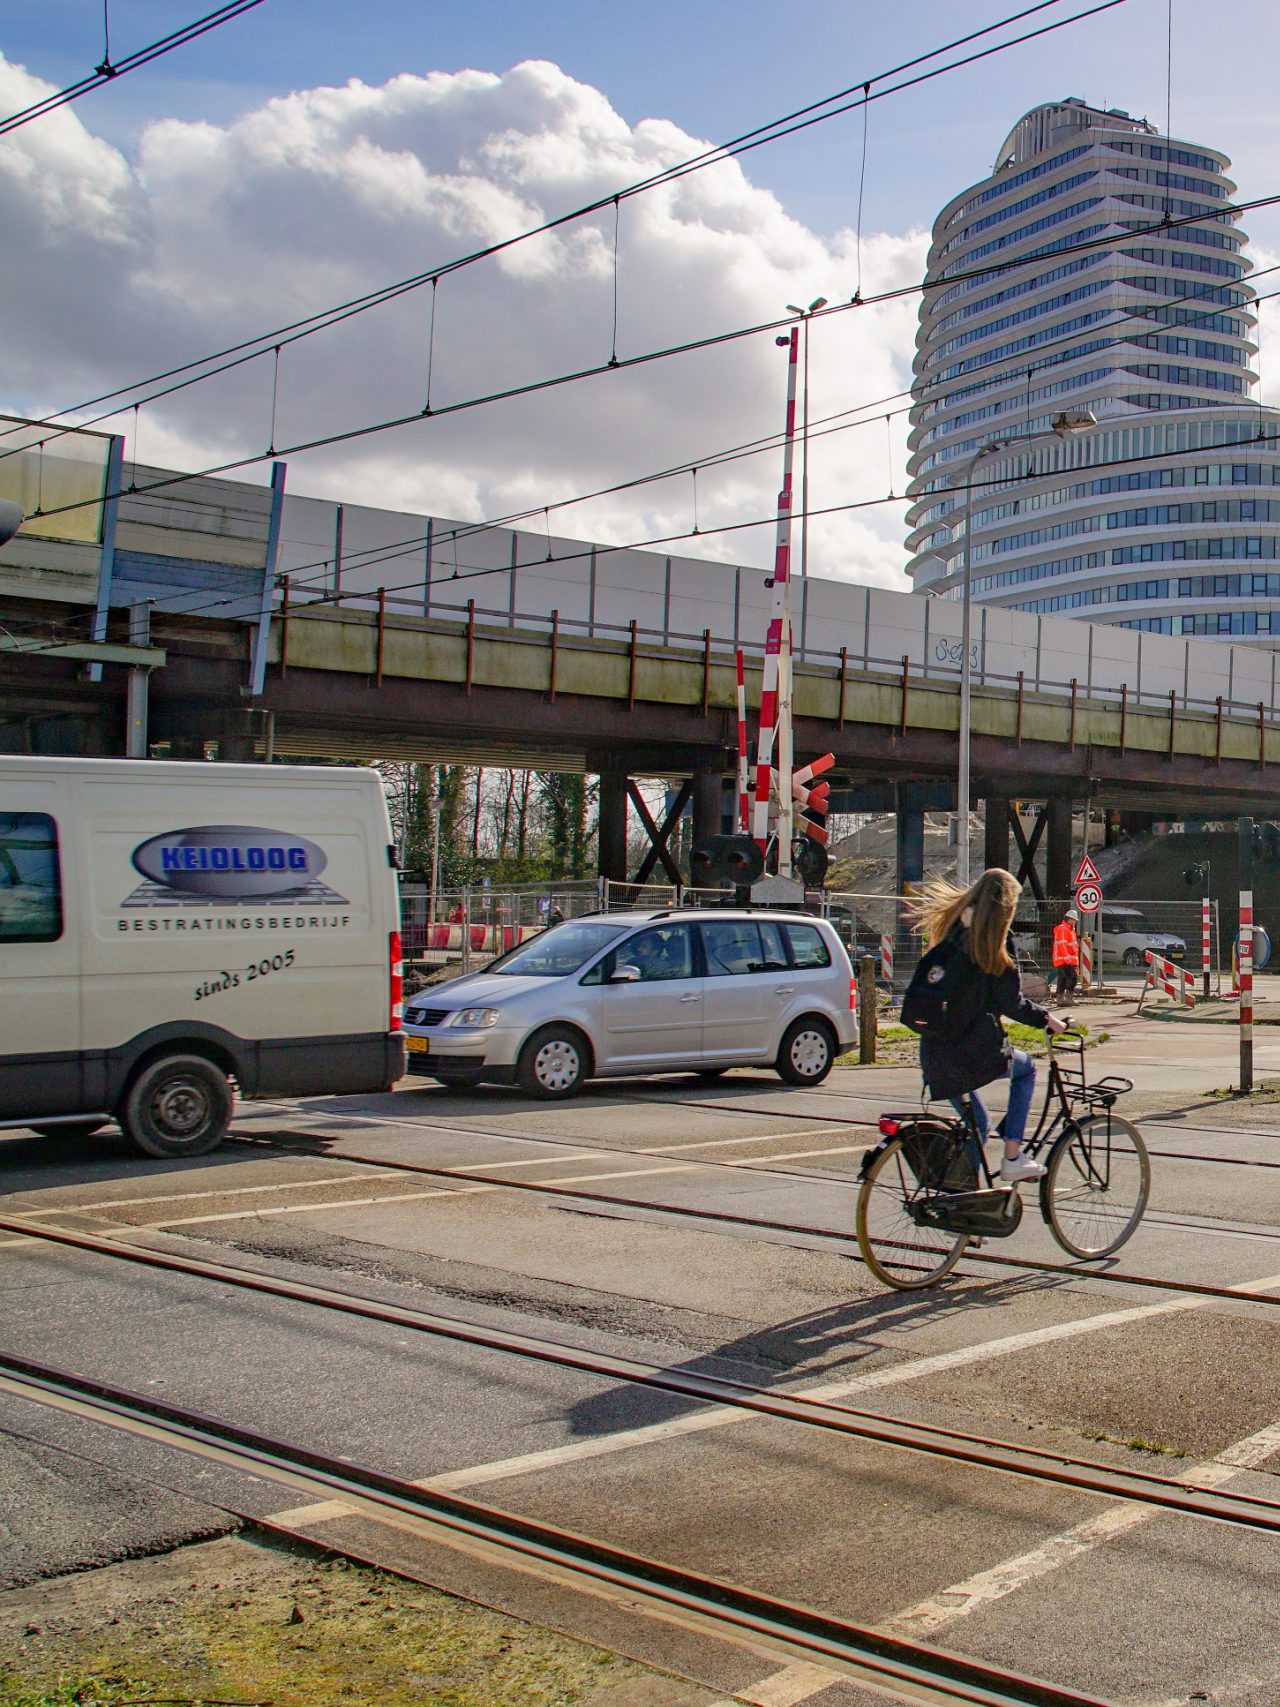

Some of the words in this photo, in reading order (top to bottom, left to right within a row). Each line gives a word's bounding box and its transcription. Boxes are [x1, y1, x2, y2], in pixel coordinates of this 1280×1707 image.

[161, 847, 308, 871] KEIOLOOG
[1081, 892, 1097, 904] 30
[117, 916, 351, 931] BESTRATINGSBEDRIJF
[194, 971, 240, 1001] sinds
[247, 949, 296, 981] 2005
